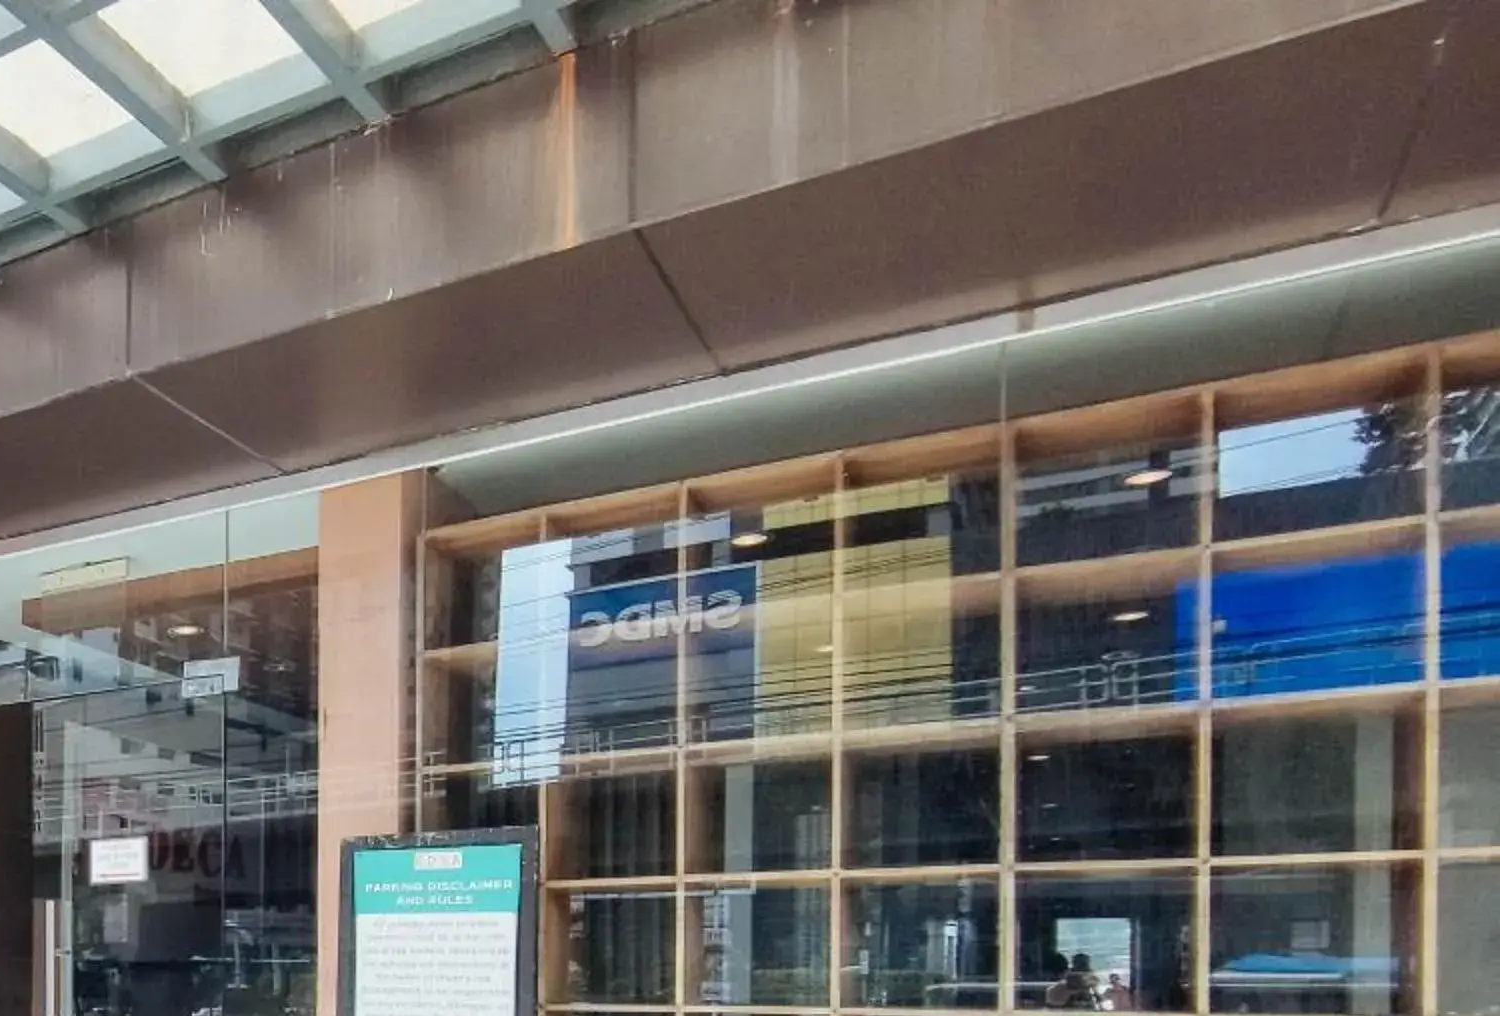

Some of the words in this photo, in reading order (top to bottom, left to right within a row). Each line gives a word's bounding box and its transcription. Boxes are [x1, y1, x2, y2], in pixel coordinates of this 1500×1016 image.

[365, 881, 423, 892] PARKING
[428, 880, 513, 891] DISCLAIMER
[396, 895, 424, 905] AND
[428, 895, 473, 905] RULES
